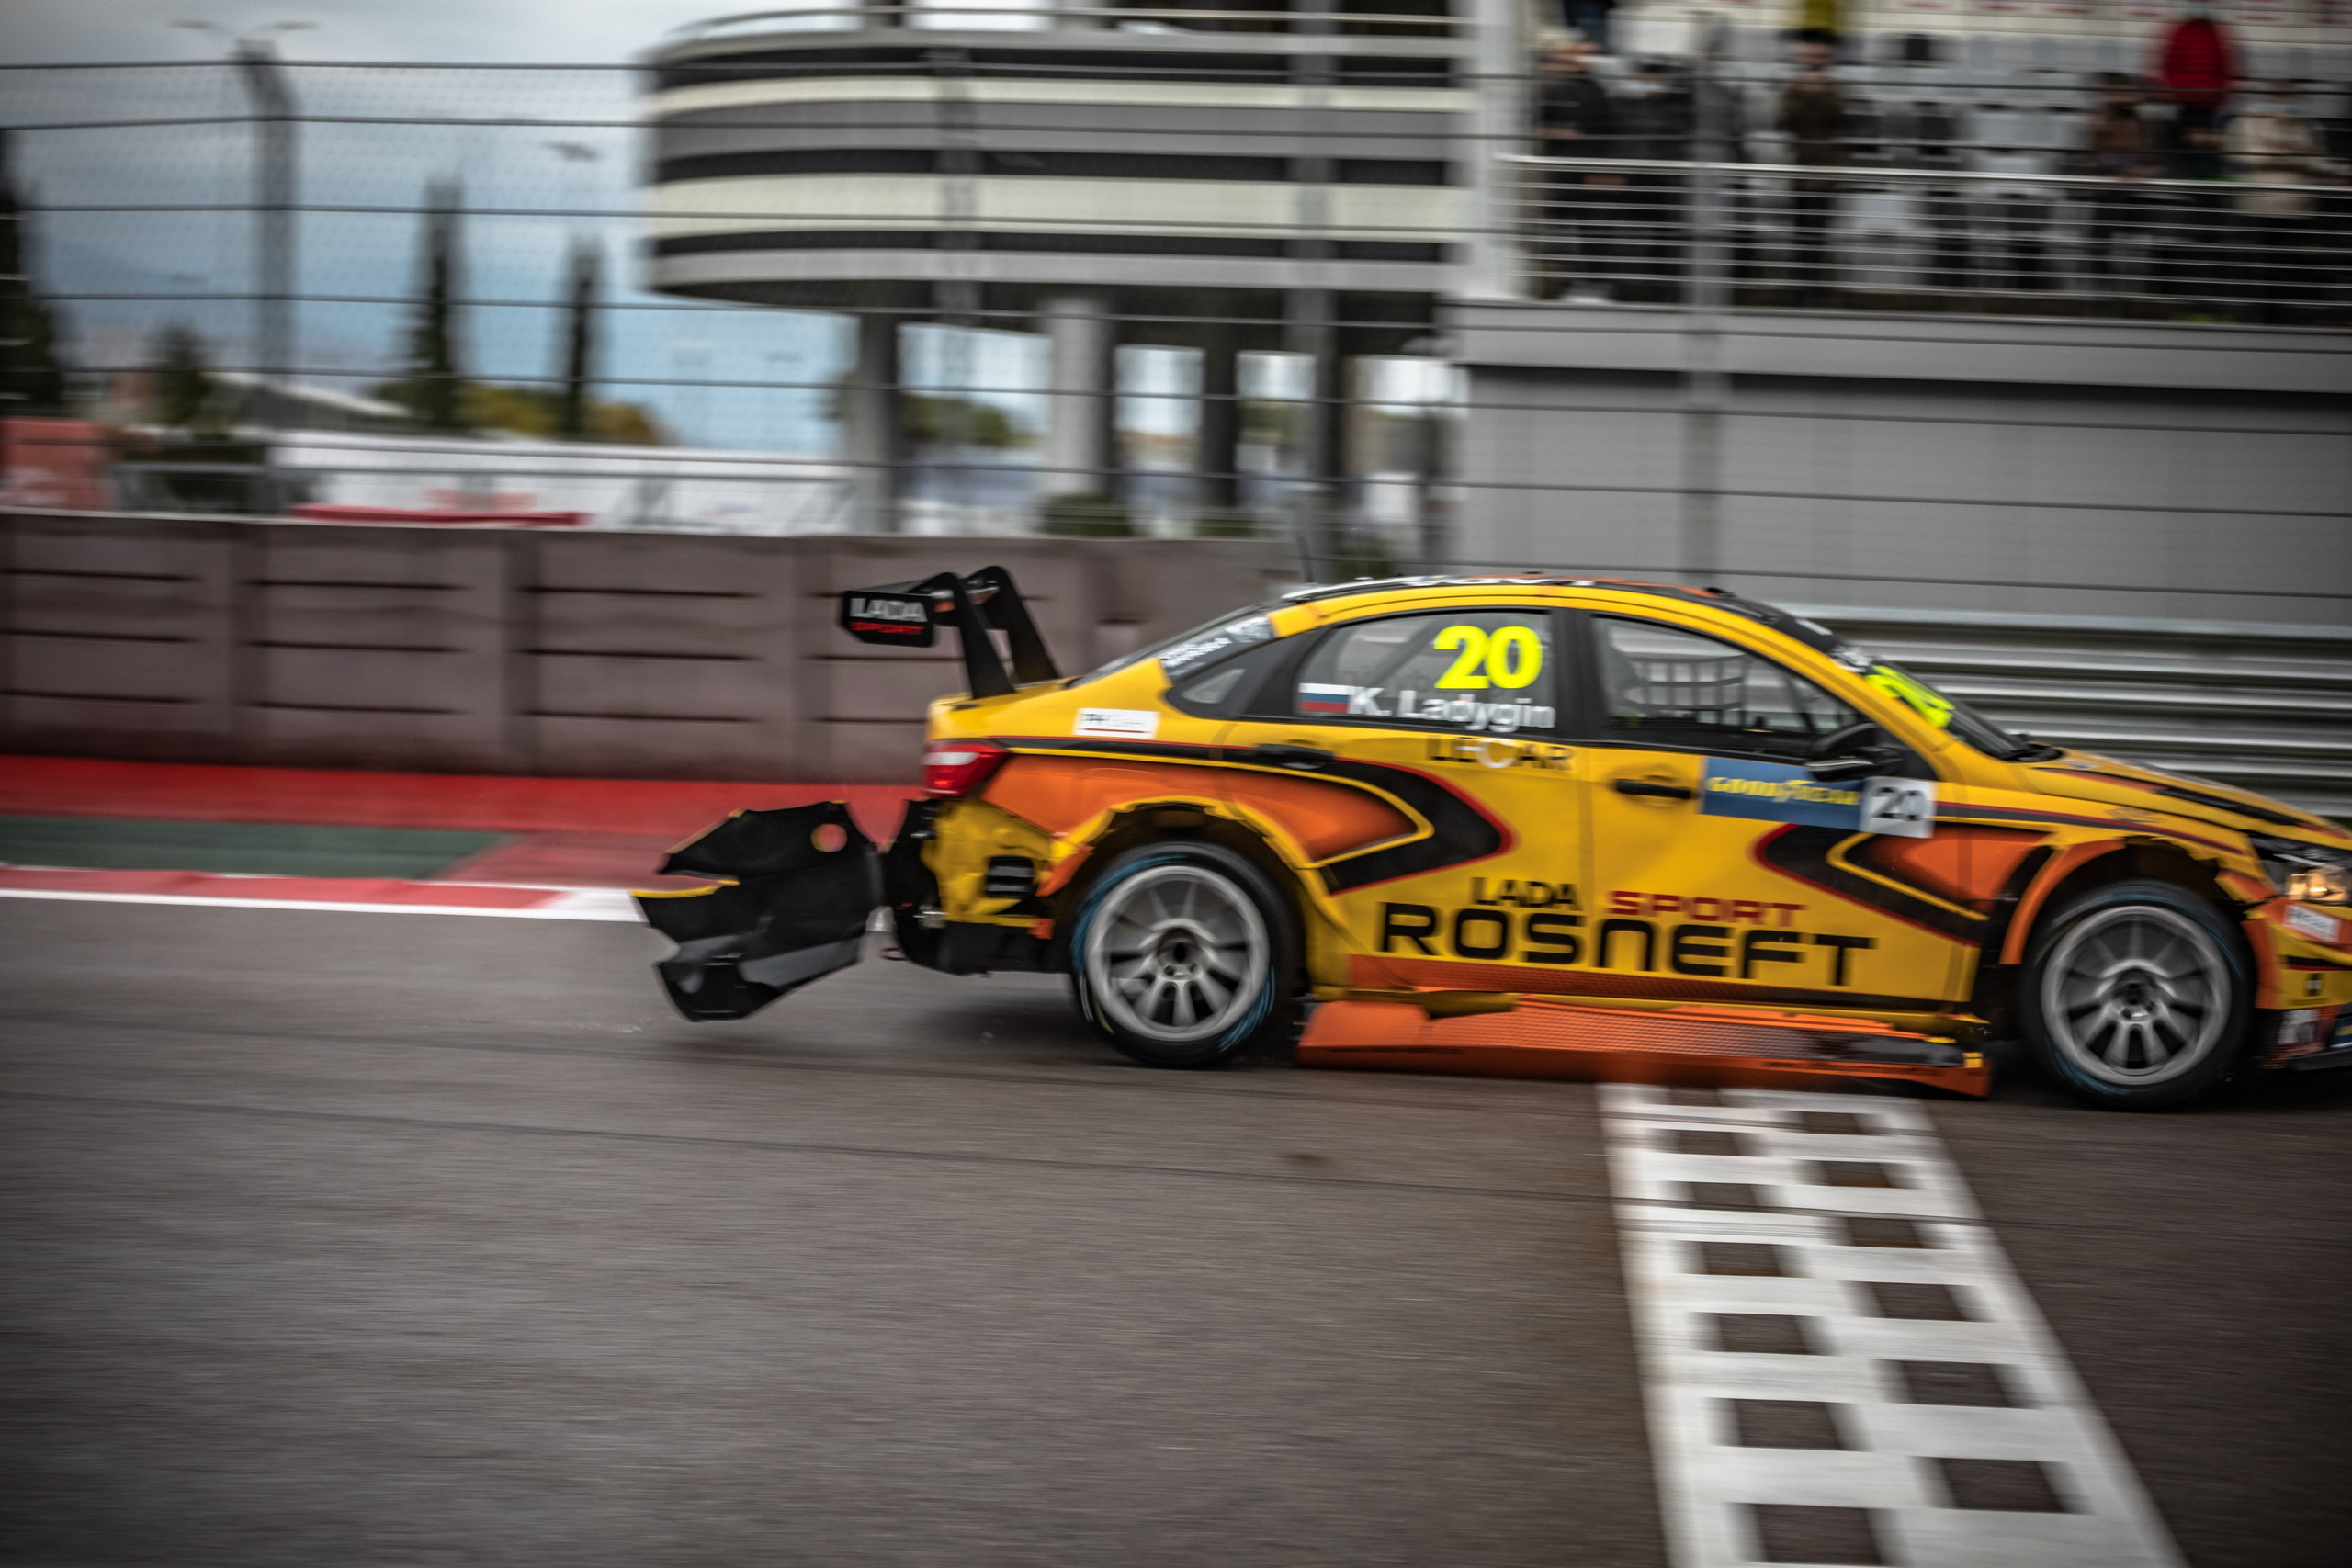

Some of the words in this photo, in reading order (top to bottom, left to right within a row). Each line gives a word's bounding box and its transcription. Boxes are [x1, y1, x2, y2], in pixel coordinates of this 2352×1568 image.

[850, 598, 928, 622] LADA
[1433, 626, 1543, 689] 20
[1348, 686, 1391, 716] K.
[1396, 690, 1555, 733] Ladygin
[1871, 786, 1925, 821] 20
[1470, 877, 1582, 911] LADA
[1605, 890, 1800, 927] SPORT
[1376, 901, 1877, 987] ROSNEFT
